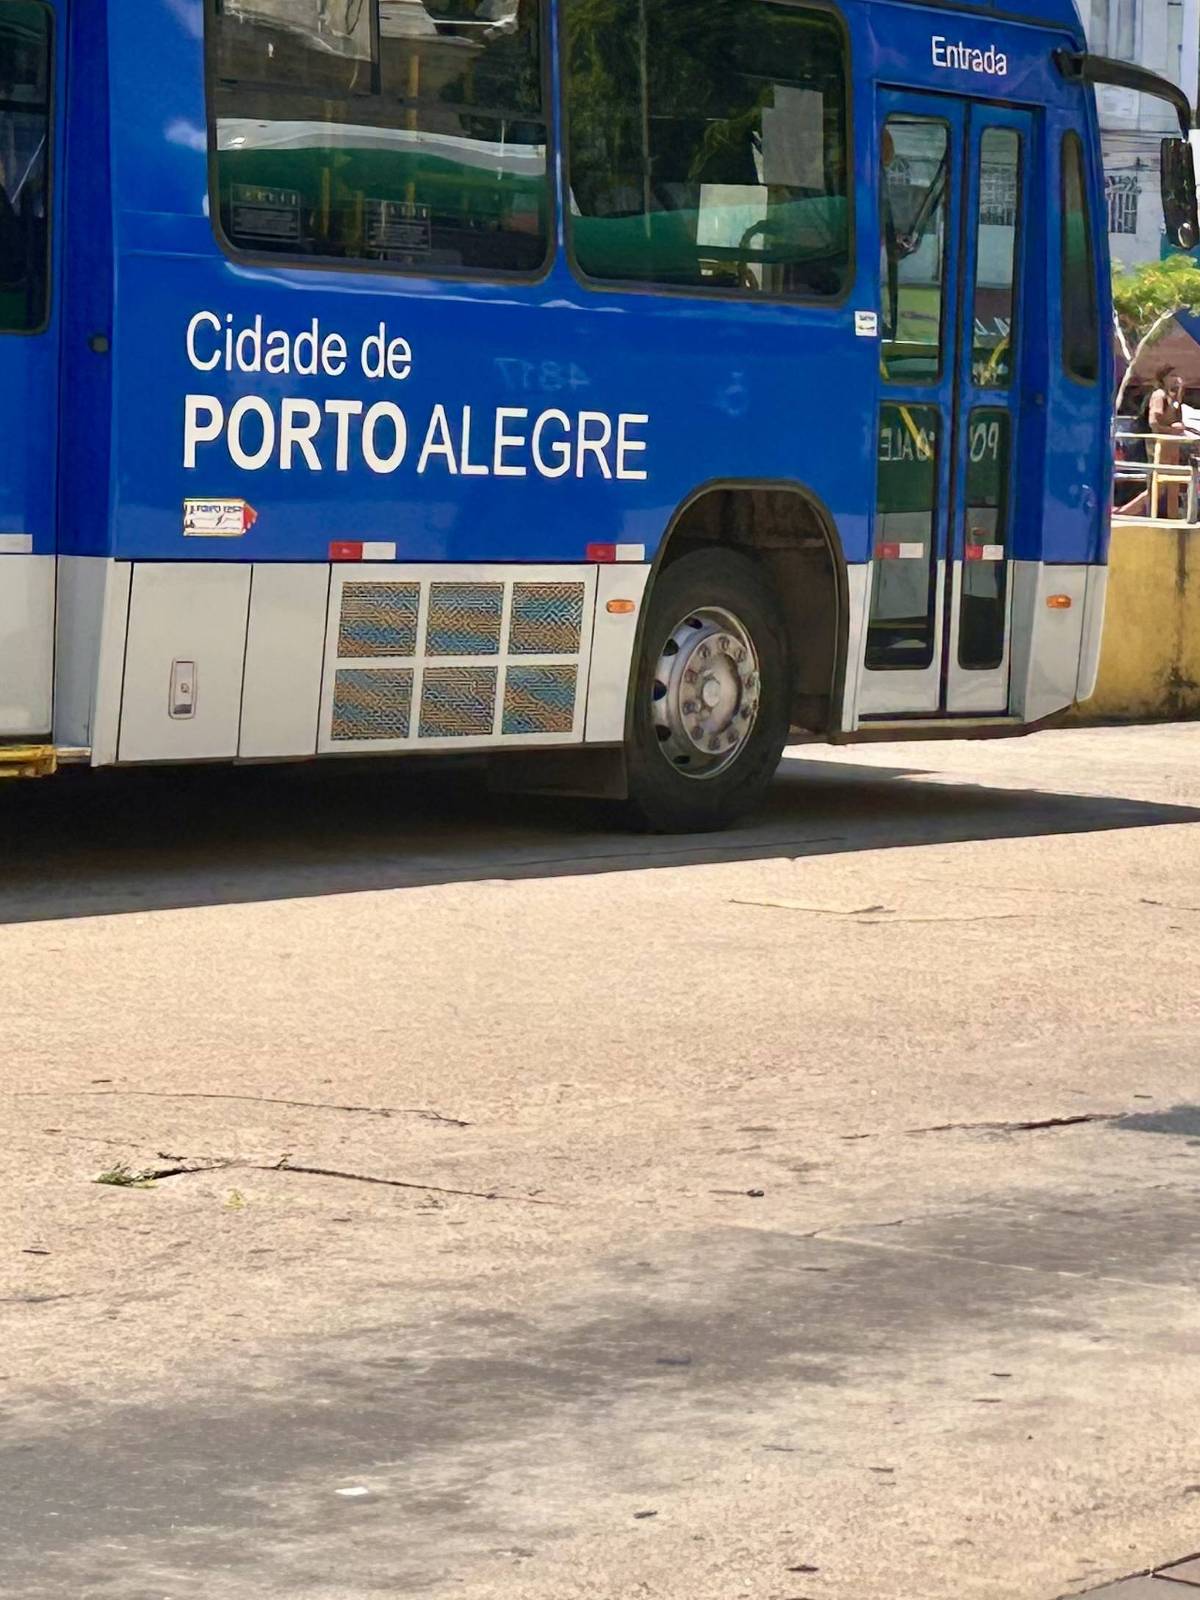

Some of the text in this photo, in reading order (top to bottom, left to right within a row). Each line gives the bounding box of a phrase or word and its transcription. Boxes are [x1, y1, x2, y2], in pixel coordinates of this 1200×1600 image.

[932, 35, 1007, 76] Entrada
[185, 310, 412, 380] Cidade de
[183, 394, 649, 481] PORTO ALEGRE
